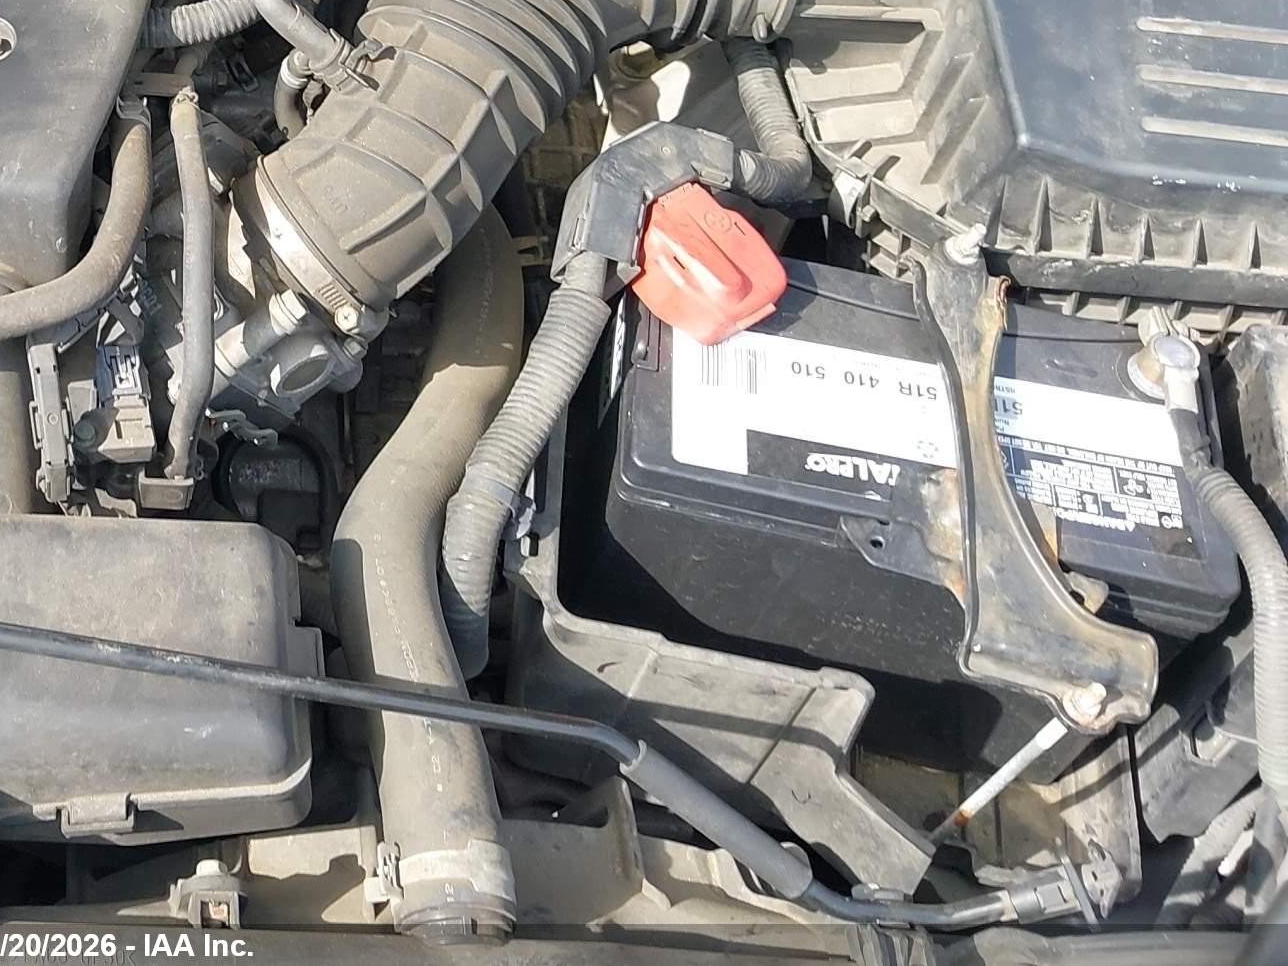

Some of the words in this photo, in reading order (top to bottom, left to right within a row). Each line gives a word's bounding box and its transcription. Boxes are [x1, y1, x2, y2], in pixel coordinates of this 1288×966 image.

[791, 361, 826, 379] 510
[844, 370, 879, 388] 410
[898, 381, 937, 400] 51R
[994, 399, 1023, 415] 51
